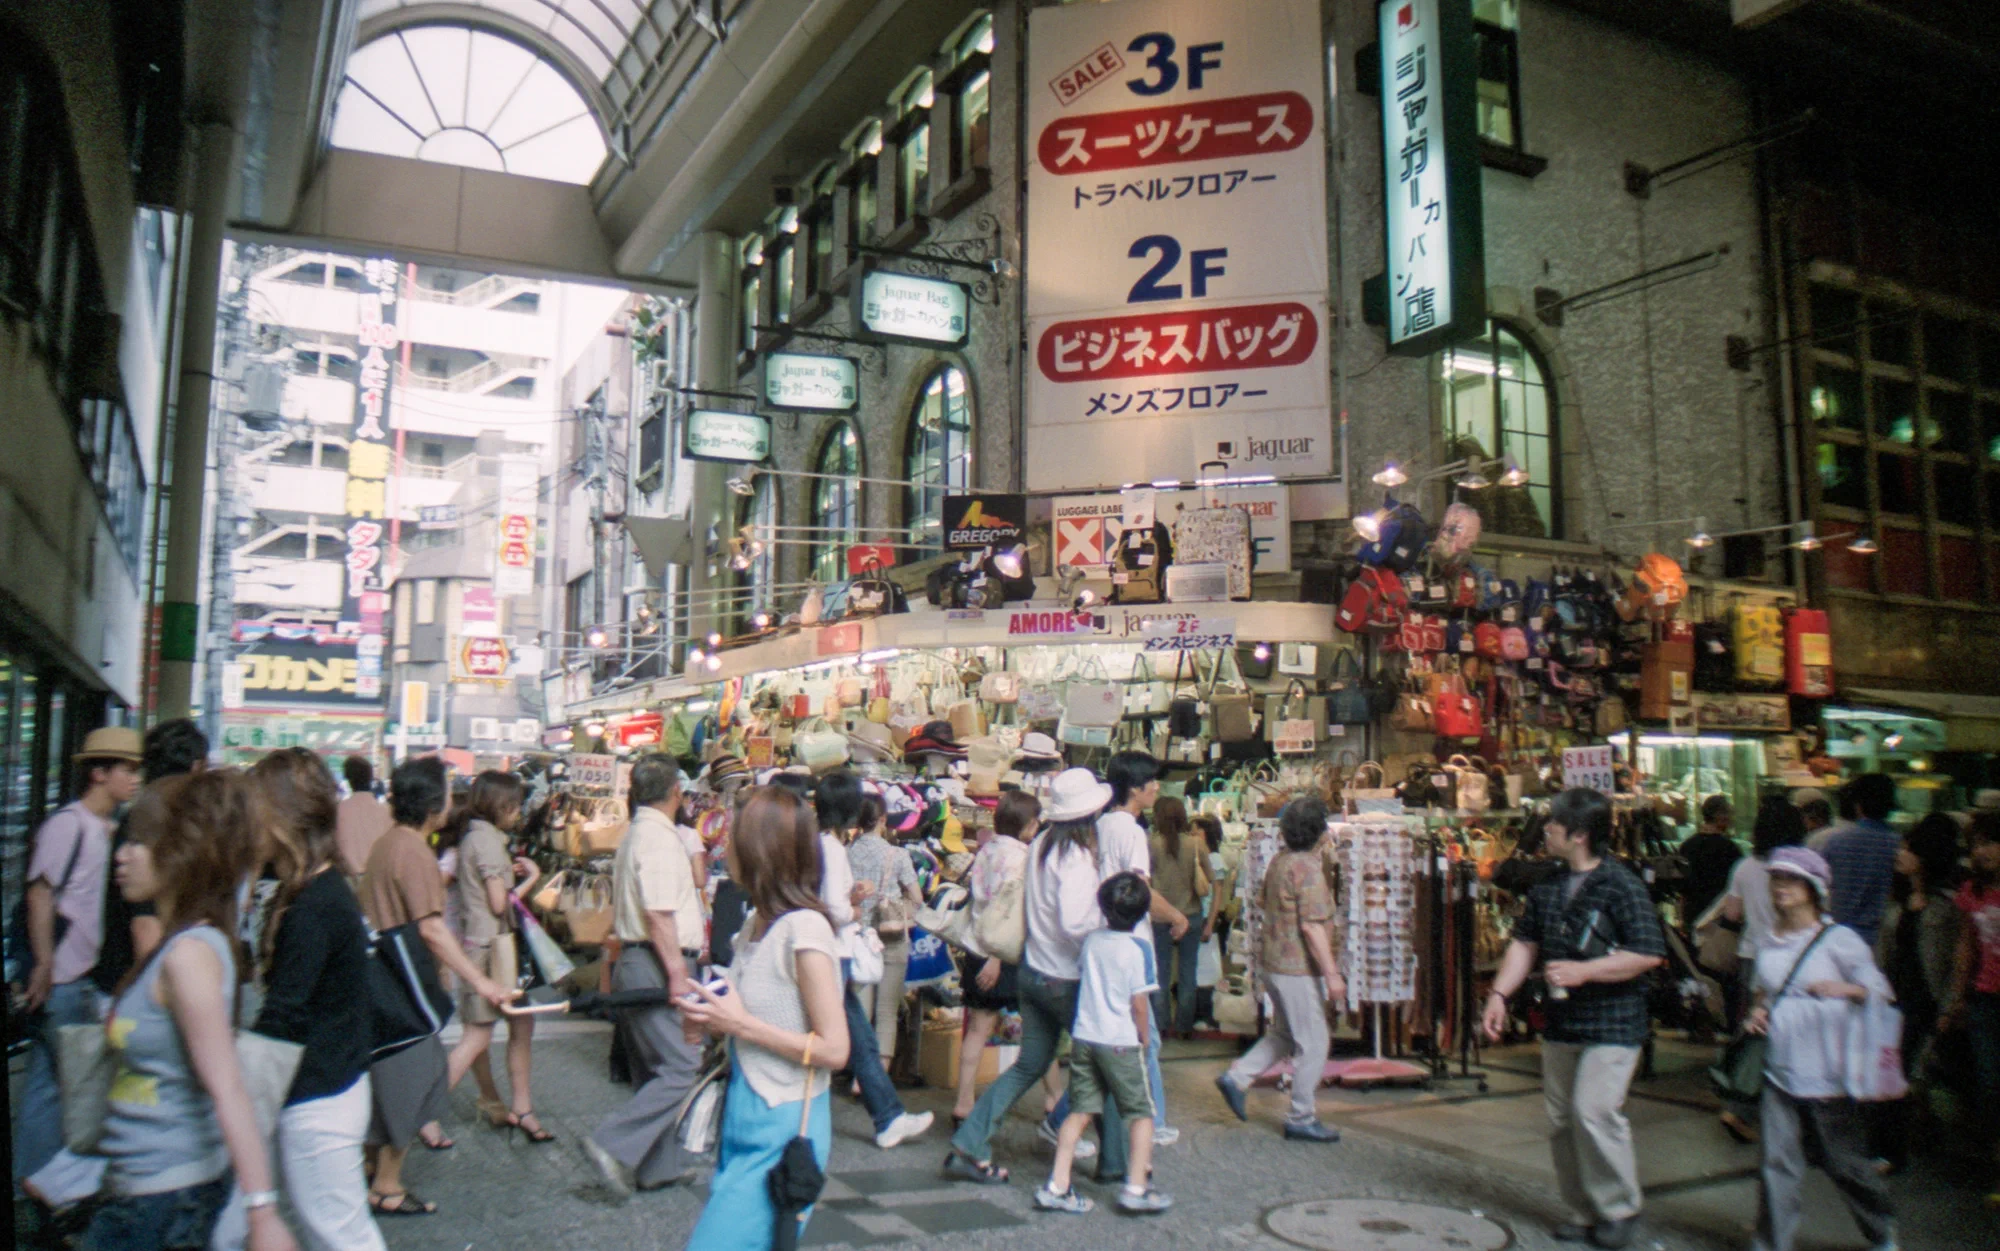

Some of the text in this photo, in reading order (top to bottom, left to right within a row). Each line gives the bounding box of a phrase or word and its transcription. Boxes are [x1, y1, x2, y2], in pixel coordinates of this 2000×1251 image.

[1058, 50, 1118, 98] SALE
[1126, 31, 1225, 97] 3F
[1055, 103, 1296, 168] スーツケース
[1074, 170, 1277, 209] トラベルフロアー
[1127, 234, 1228, 303] 2F
[1054, 312, 1304, 373] ビジネスバッグ
[1085, 383, 1268, 417] メンズフロアー
[1244, 435, 1315, 461] jaguar
[1057, 503, 1124, 516] LUGGAGE LABE
[1008, 611, 1076, 634] AMORE
[575, 757, 610, 768] SALE
[1565, 749, 1609, 768] SALE
